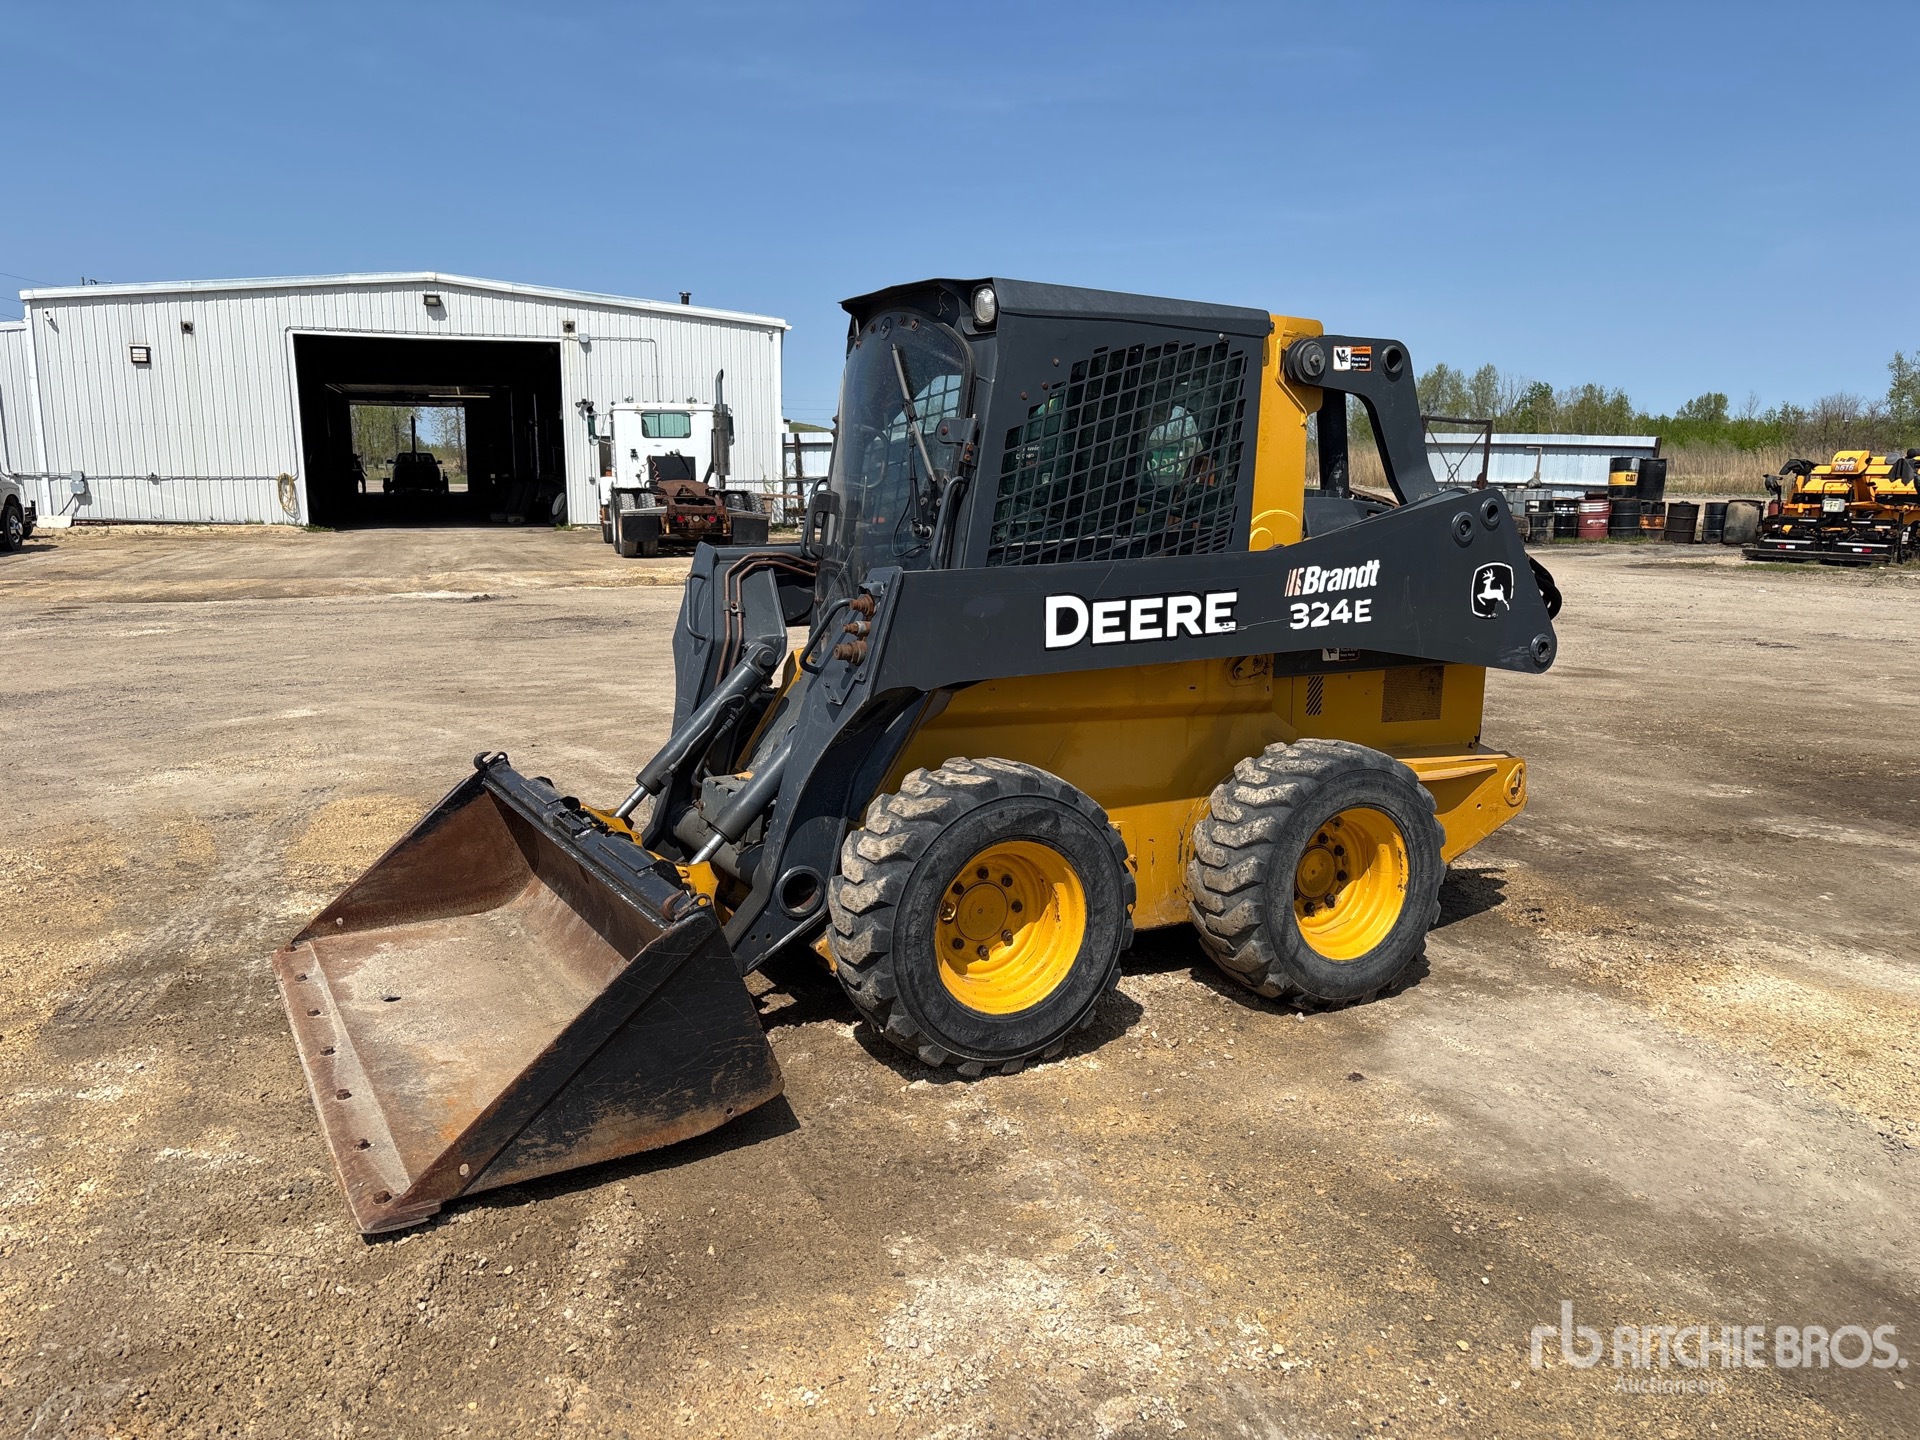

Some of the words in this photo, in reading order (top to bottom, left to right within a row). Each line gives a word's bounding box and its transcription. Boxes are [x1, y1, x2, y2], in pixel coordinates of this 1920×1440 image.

[1625, 474, 1637, 482] CAT
[1301, 559, 1380, 595] Brandt
[1045, 591, 1238, 649] DEERE
[1289, 598, 1372, 630] 324E
